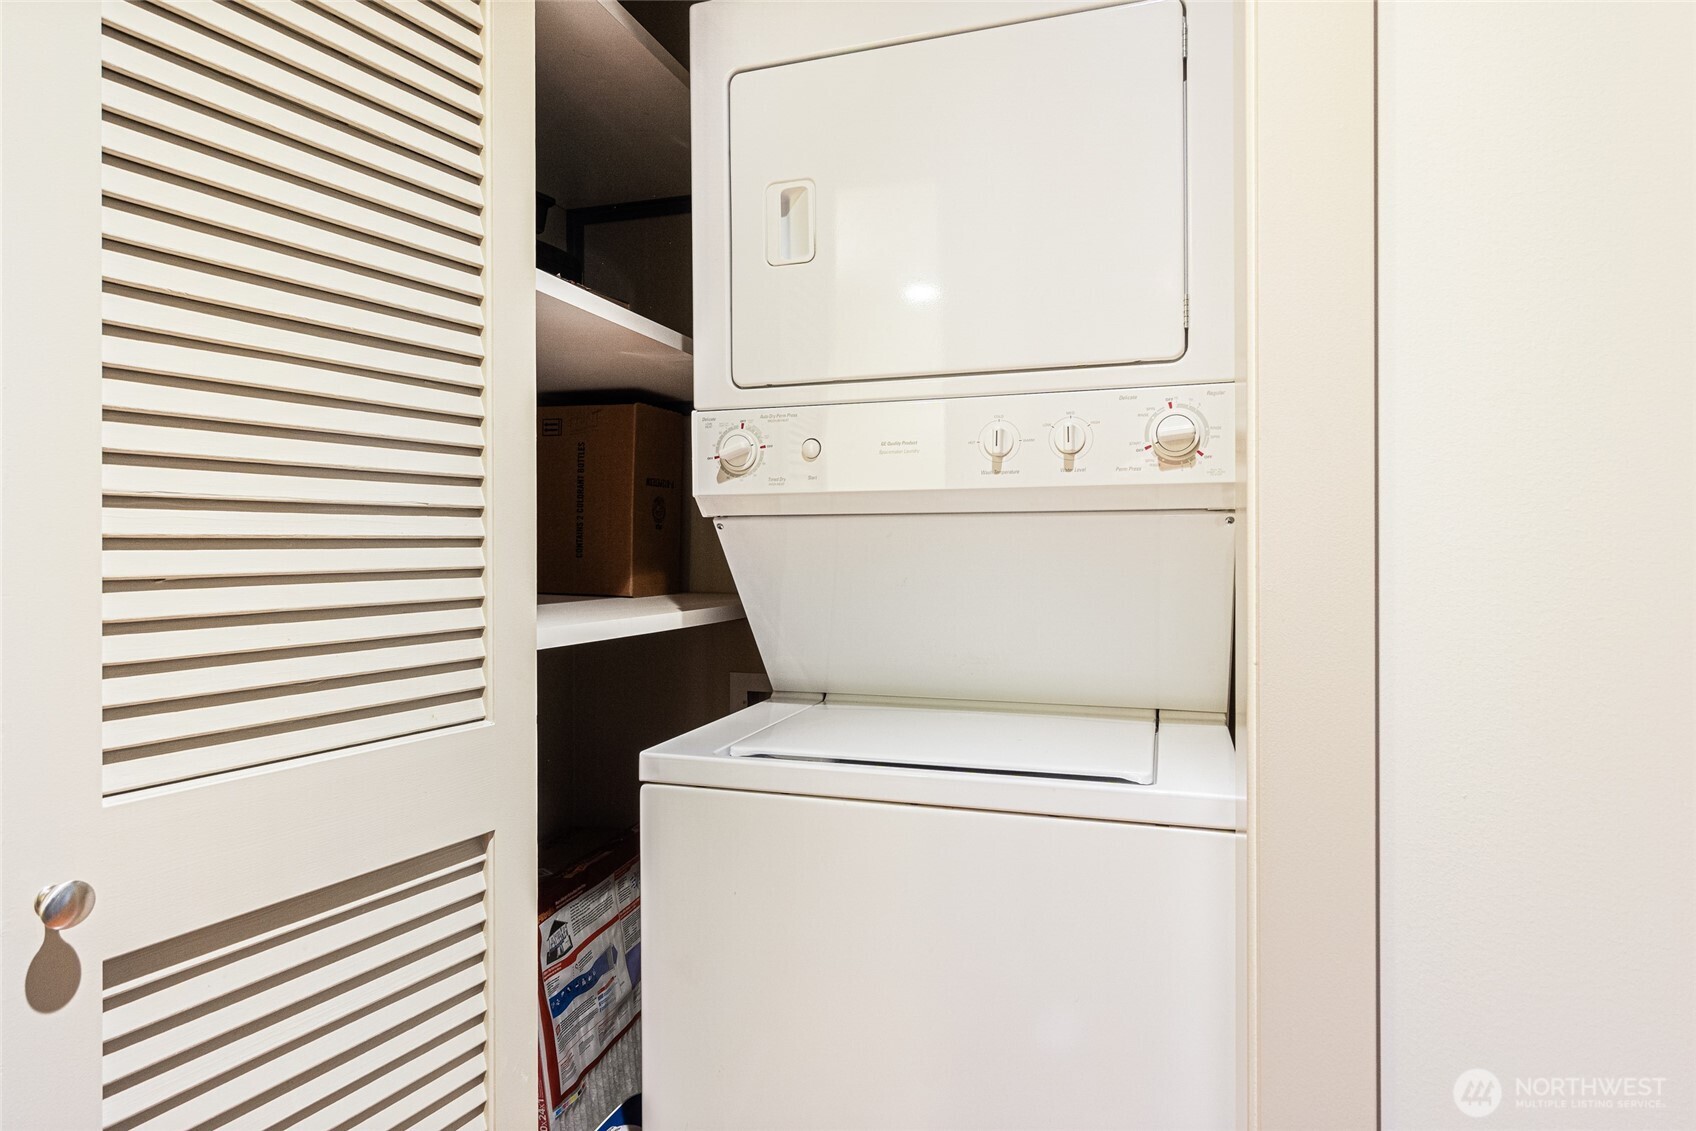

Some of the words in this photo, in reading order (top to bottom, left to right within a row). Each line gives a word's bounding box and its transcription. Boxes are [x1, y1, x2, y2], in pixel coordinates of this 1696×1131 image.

[577, 441, 586, 473] BOTTLES
[576, 475, 585, 513] COLORANT
[575, 522, 584, 559] CONTAINS
